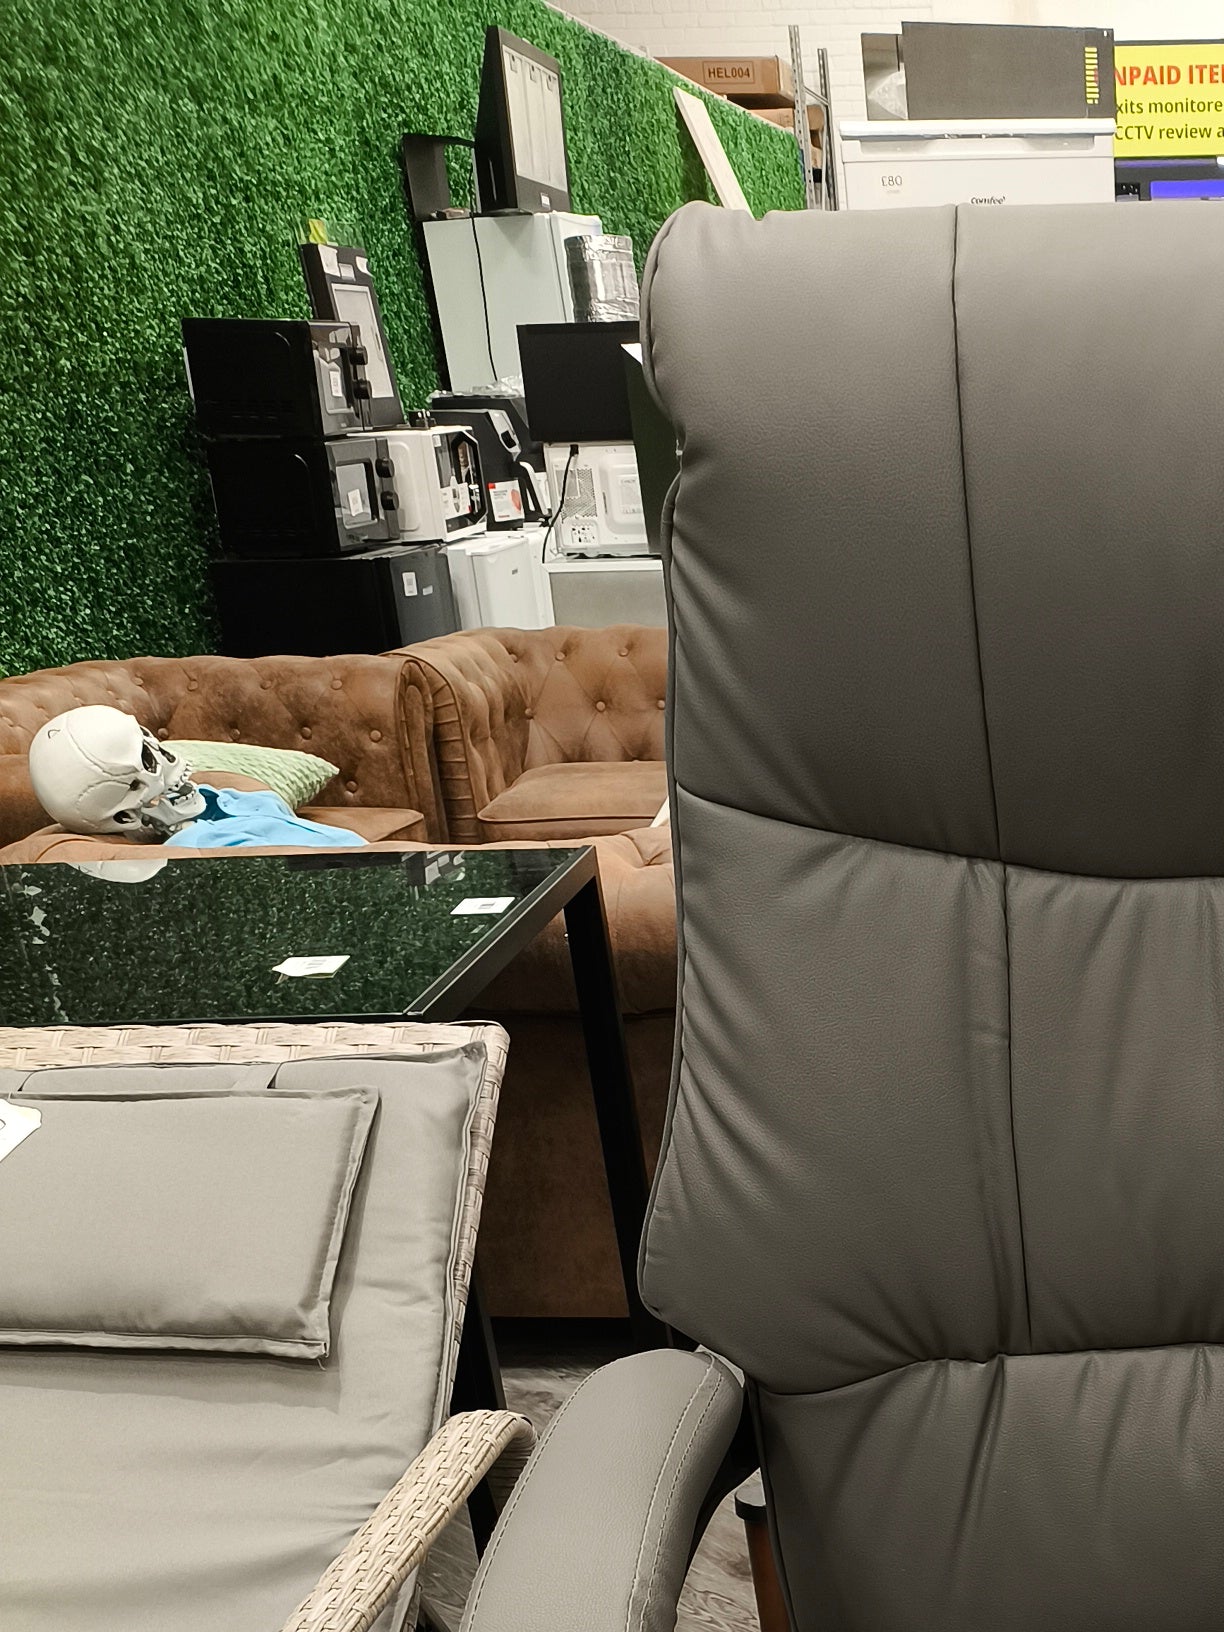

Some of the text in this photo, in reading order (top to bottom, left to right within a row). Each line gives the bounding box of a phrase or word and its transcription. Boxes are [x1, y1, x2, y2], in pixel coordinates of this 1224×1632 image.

[708, 67, 750, 79] HEL004
[1115, 65, 1181, 86] NPAID
[1116, 98, 1144, 114] xits
[1115, 125, 1154, 141] CCTV
[1159, 123, 1212, 140] review
